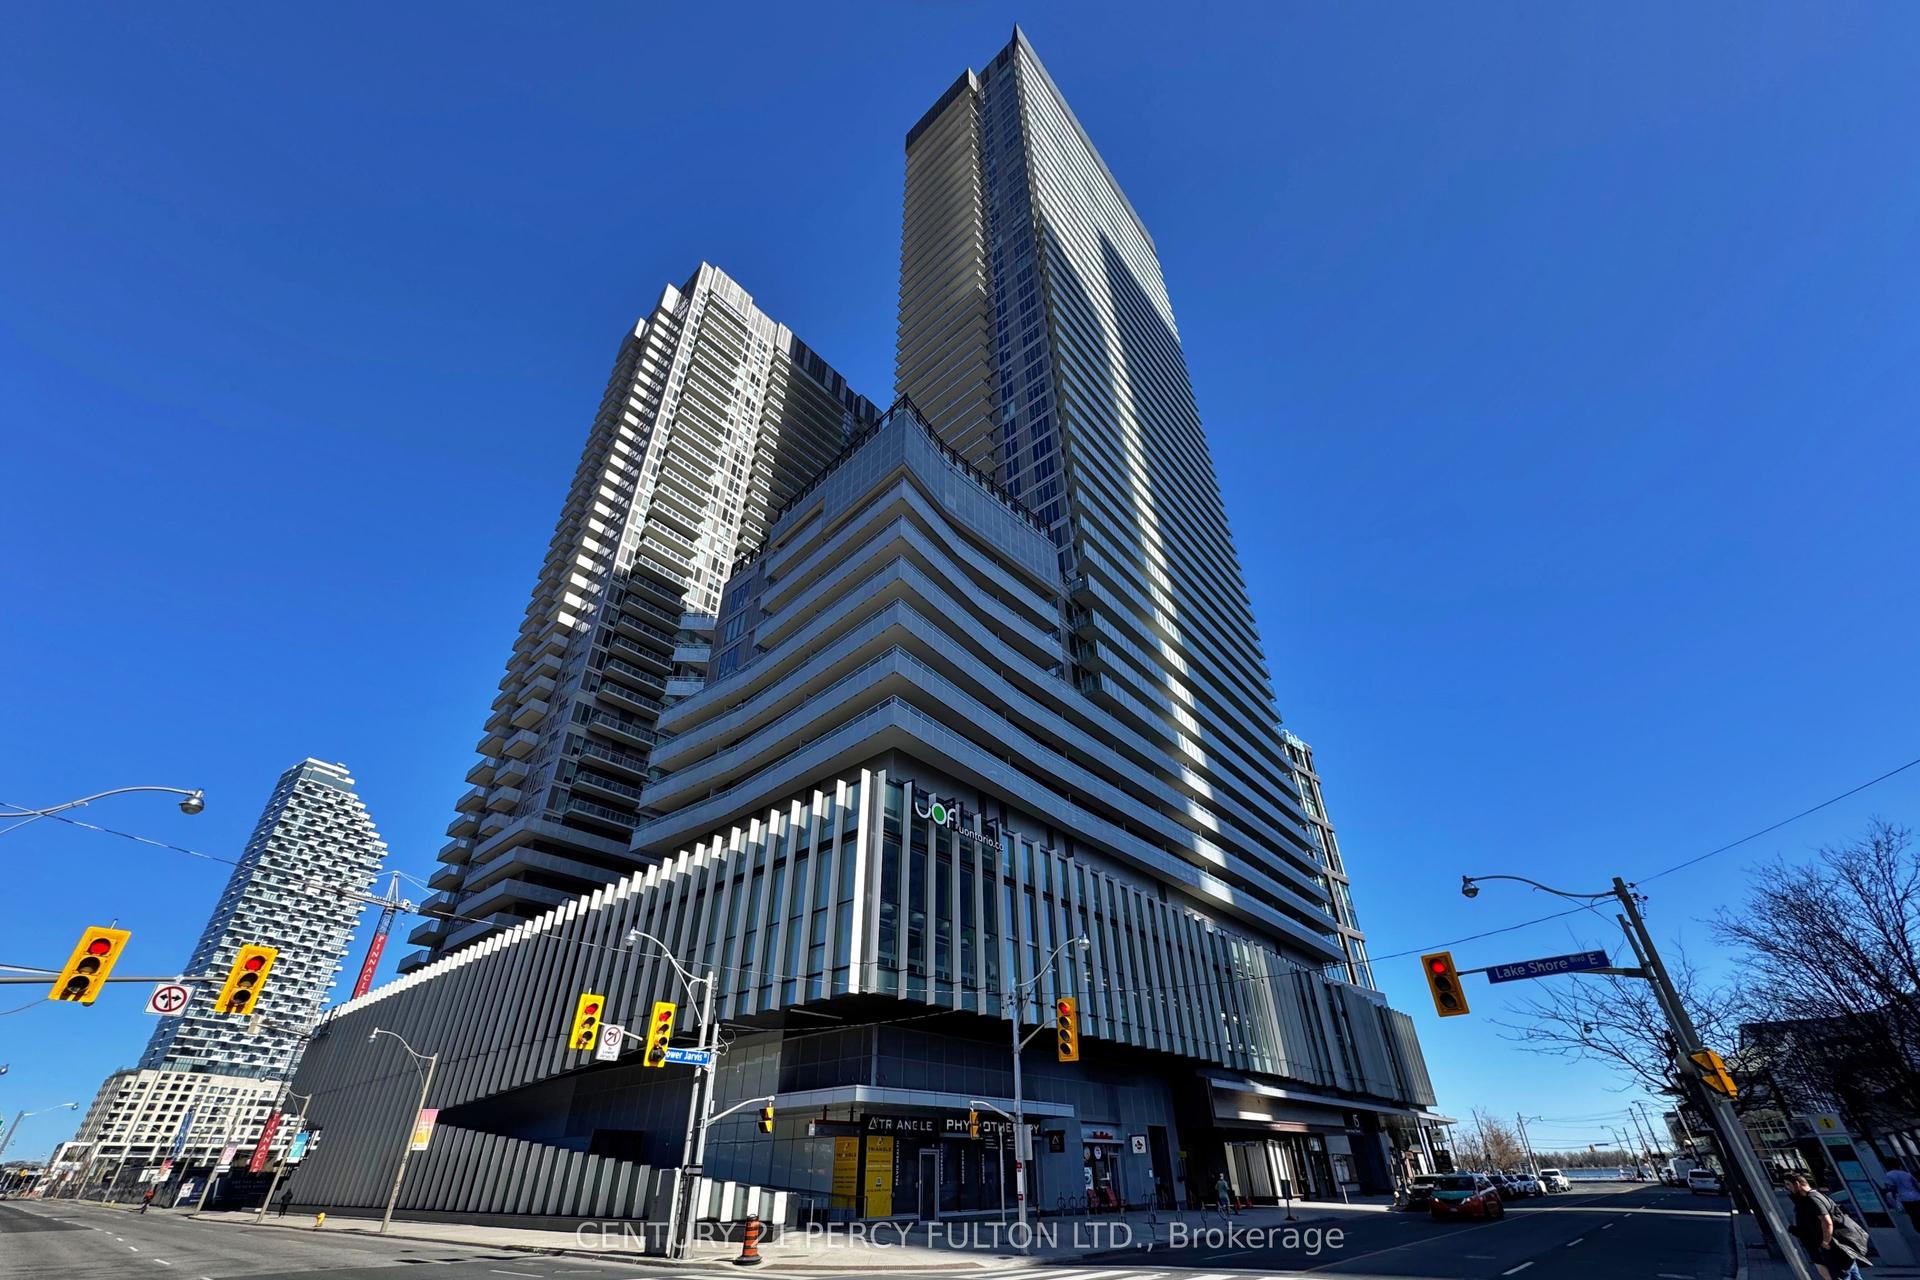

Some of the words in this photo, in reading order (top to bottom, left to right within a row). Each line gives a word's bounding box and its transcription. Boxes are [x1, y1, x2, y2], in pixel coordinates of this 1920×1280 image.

[1495, 966, 1526, 979] Lake
[1528, 959, 1568, 974] Shore
[1569, 955, 1585, 963] Blvd
[1587, 953, 1598, 965] E
[665, 1051, 683, 1059] ower
[684, 1052, 703, 1061] Jarvis
